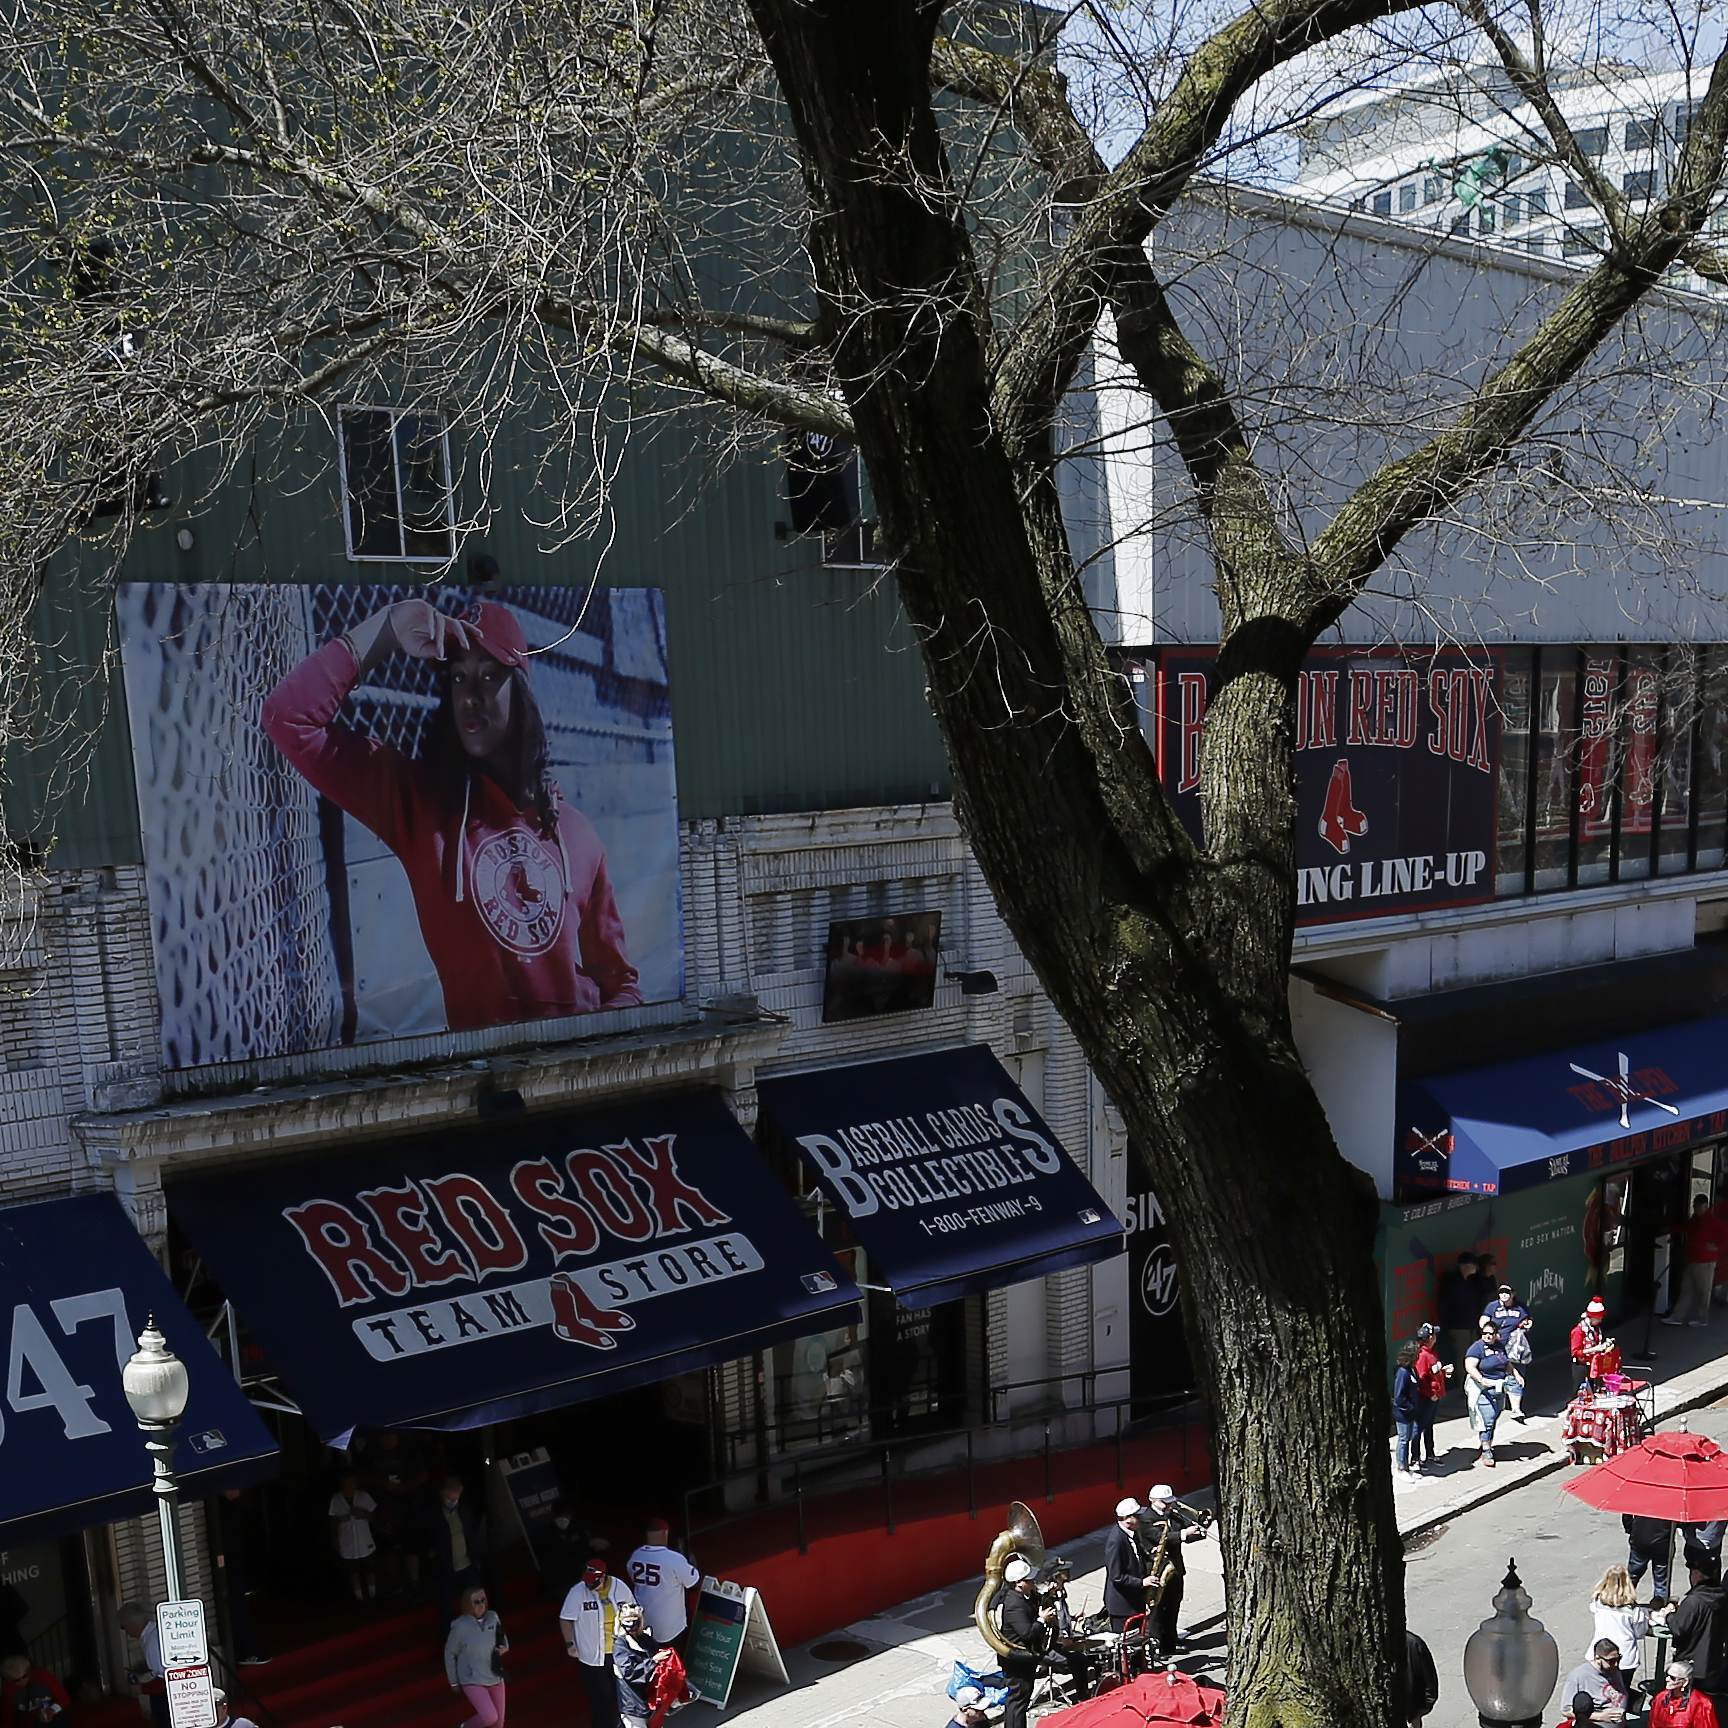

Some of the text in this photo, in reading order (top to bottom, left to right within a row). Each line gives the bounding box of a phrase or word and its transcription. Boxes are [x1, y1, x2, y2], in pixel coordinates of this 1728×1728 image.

[1347, 669, 1419, 749] RED
[1428, 668, 1495, 774] SOX
[484, 836, 553, 872] BOSTON
[1360, 849, 1487, 900] LINE-UP
[484, 896, 558, 944] RED SOX
[795, 1113, 941, 1218] BASEBALL
[282, 1133, 733, 1308] RED SOX
[918, 1194, 1044, 1237] 1-800-FENWAY-9
[366, 1239, 749, 1354] TEAM STORE
[1525, 1268, 1565, 1308] JIM BEAM
[896, 1312, 913, 1327] FAN
[896, 1324, 931, 1343] A STORY
[632, 1561, 660, 1586] 25
[162, 1608, 199, 1620] Parking
[583, 1600, 600, 1611] RED
[165, 1620, 199, 1630] 2 Hour
[170, 1630, 196, 1641] Limit
[168, 1667, 209, 1681] TOW ZONE
[180, 1681, 197, 1691] NO
[173, 1689, 210, 1700] STOPPING
